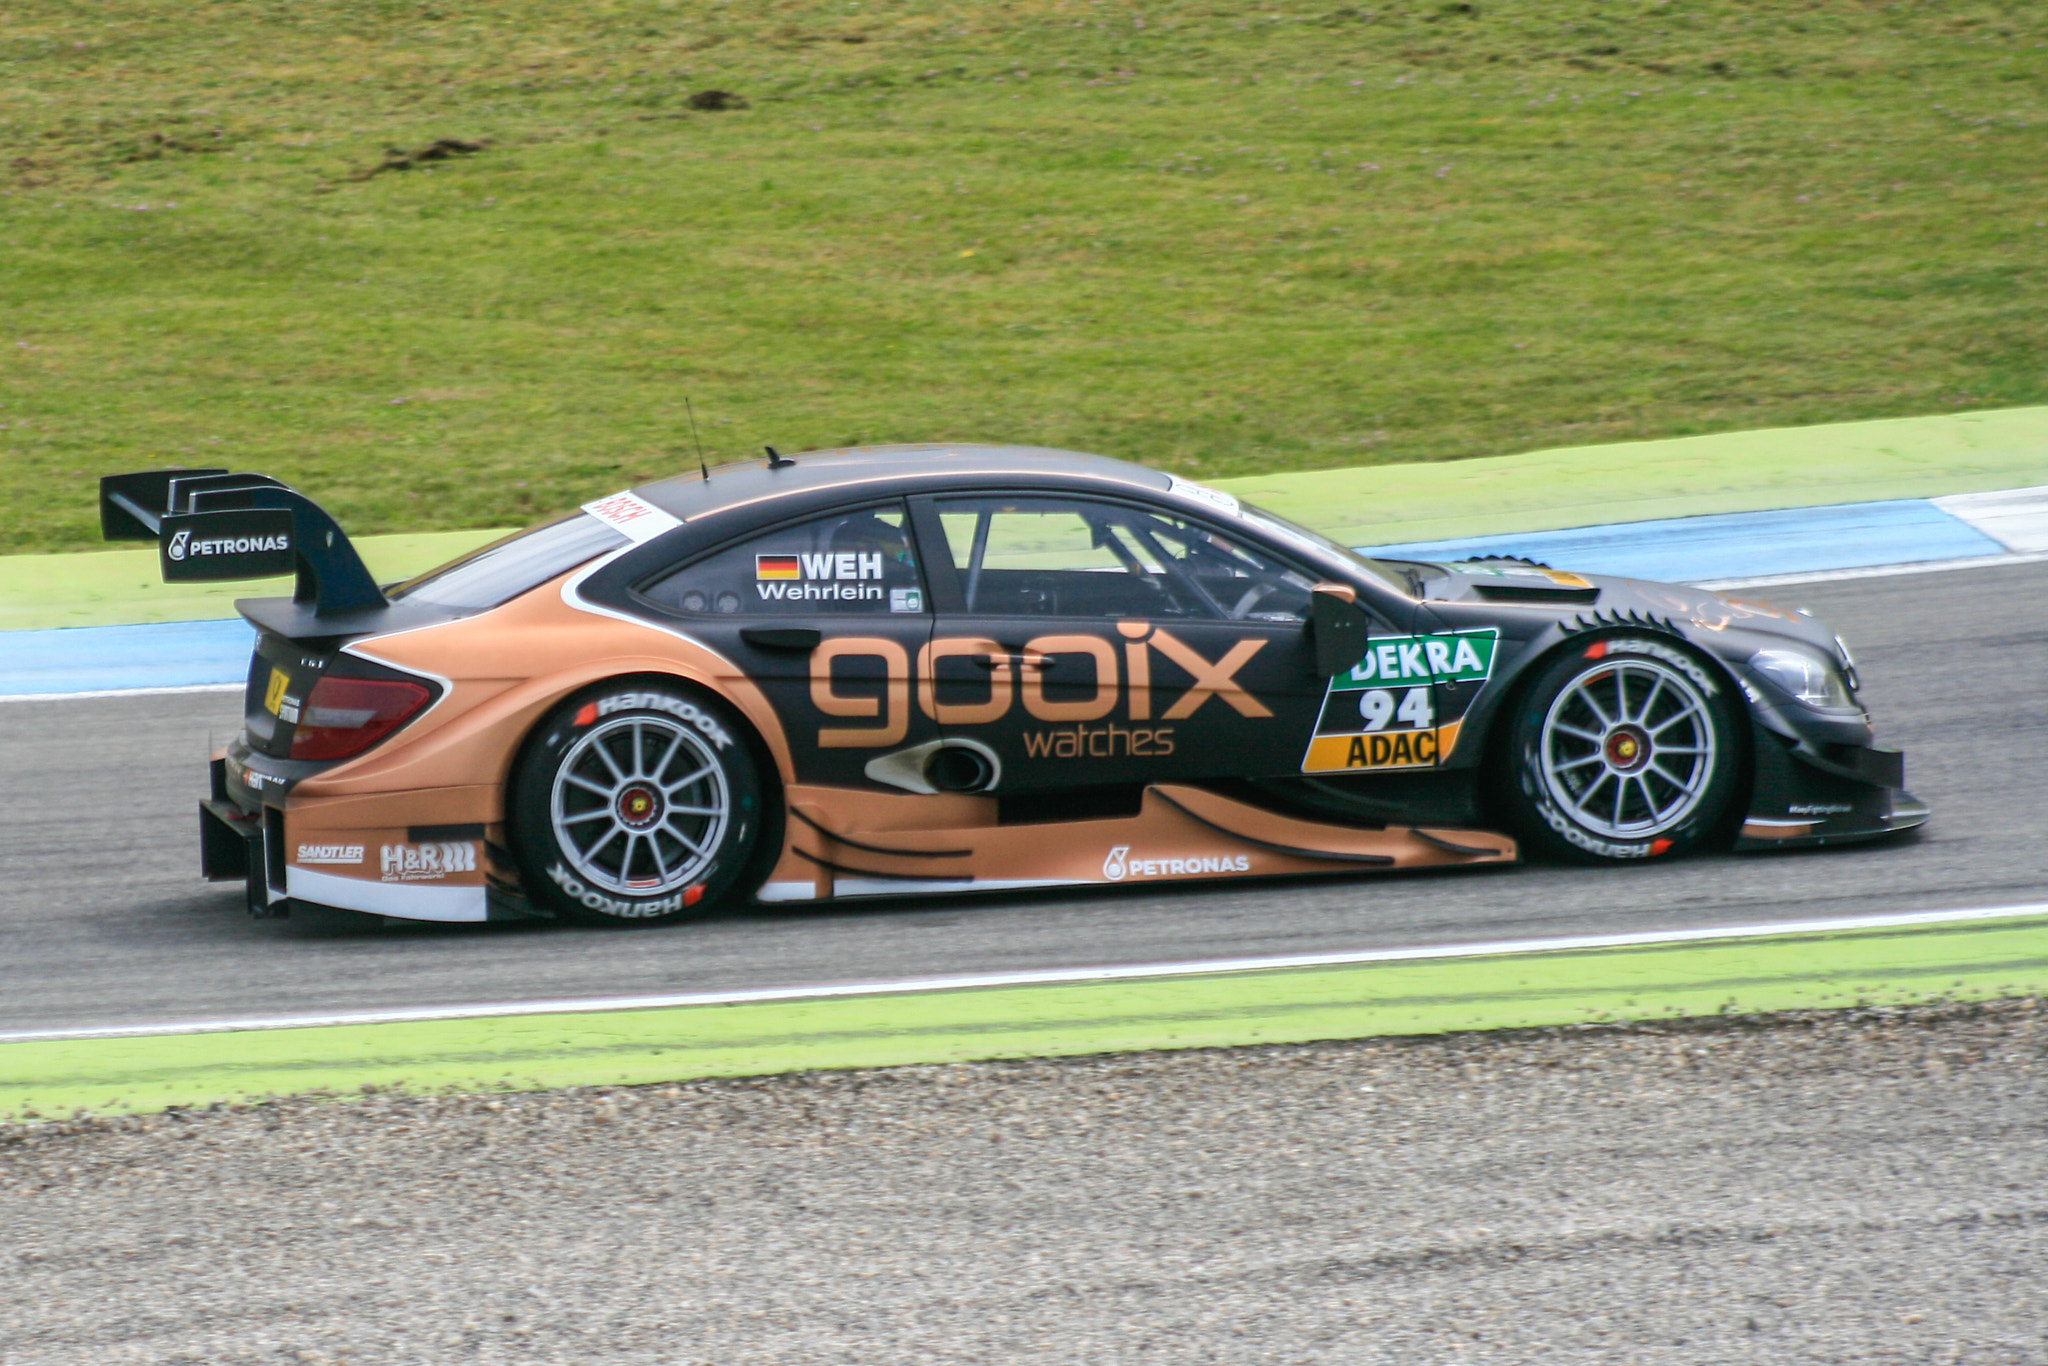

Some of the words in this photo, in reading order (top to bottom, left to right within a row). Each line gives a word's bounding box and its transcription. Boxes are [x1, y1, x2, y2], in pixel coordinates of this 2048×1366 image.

[190, 535, 288, 556] PETRONAS
[802, 553, 882, 580] WEH
[757, 583, 882, 601] Wehrlein
[810, 621, 1274, 748] gooix
[1359, 687, 1433, 731] 94
[1023, 723, 1175, 758] watches
[1346, 731, 1436, 768] ADAC
[297, 844, 365, 859] SANDTLER
[1129, 855, 1250, 876] PETRONAS
